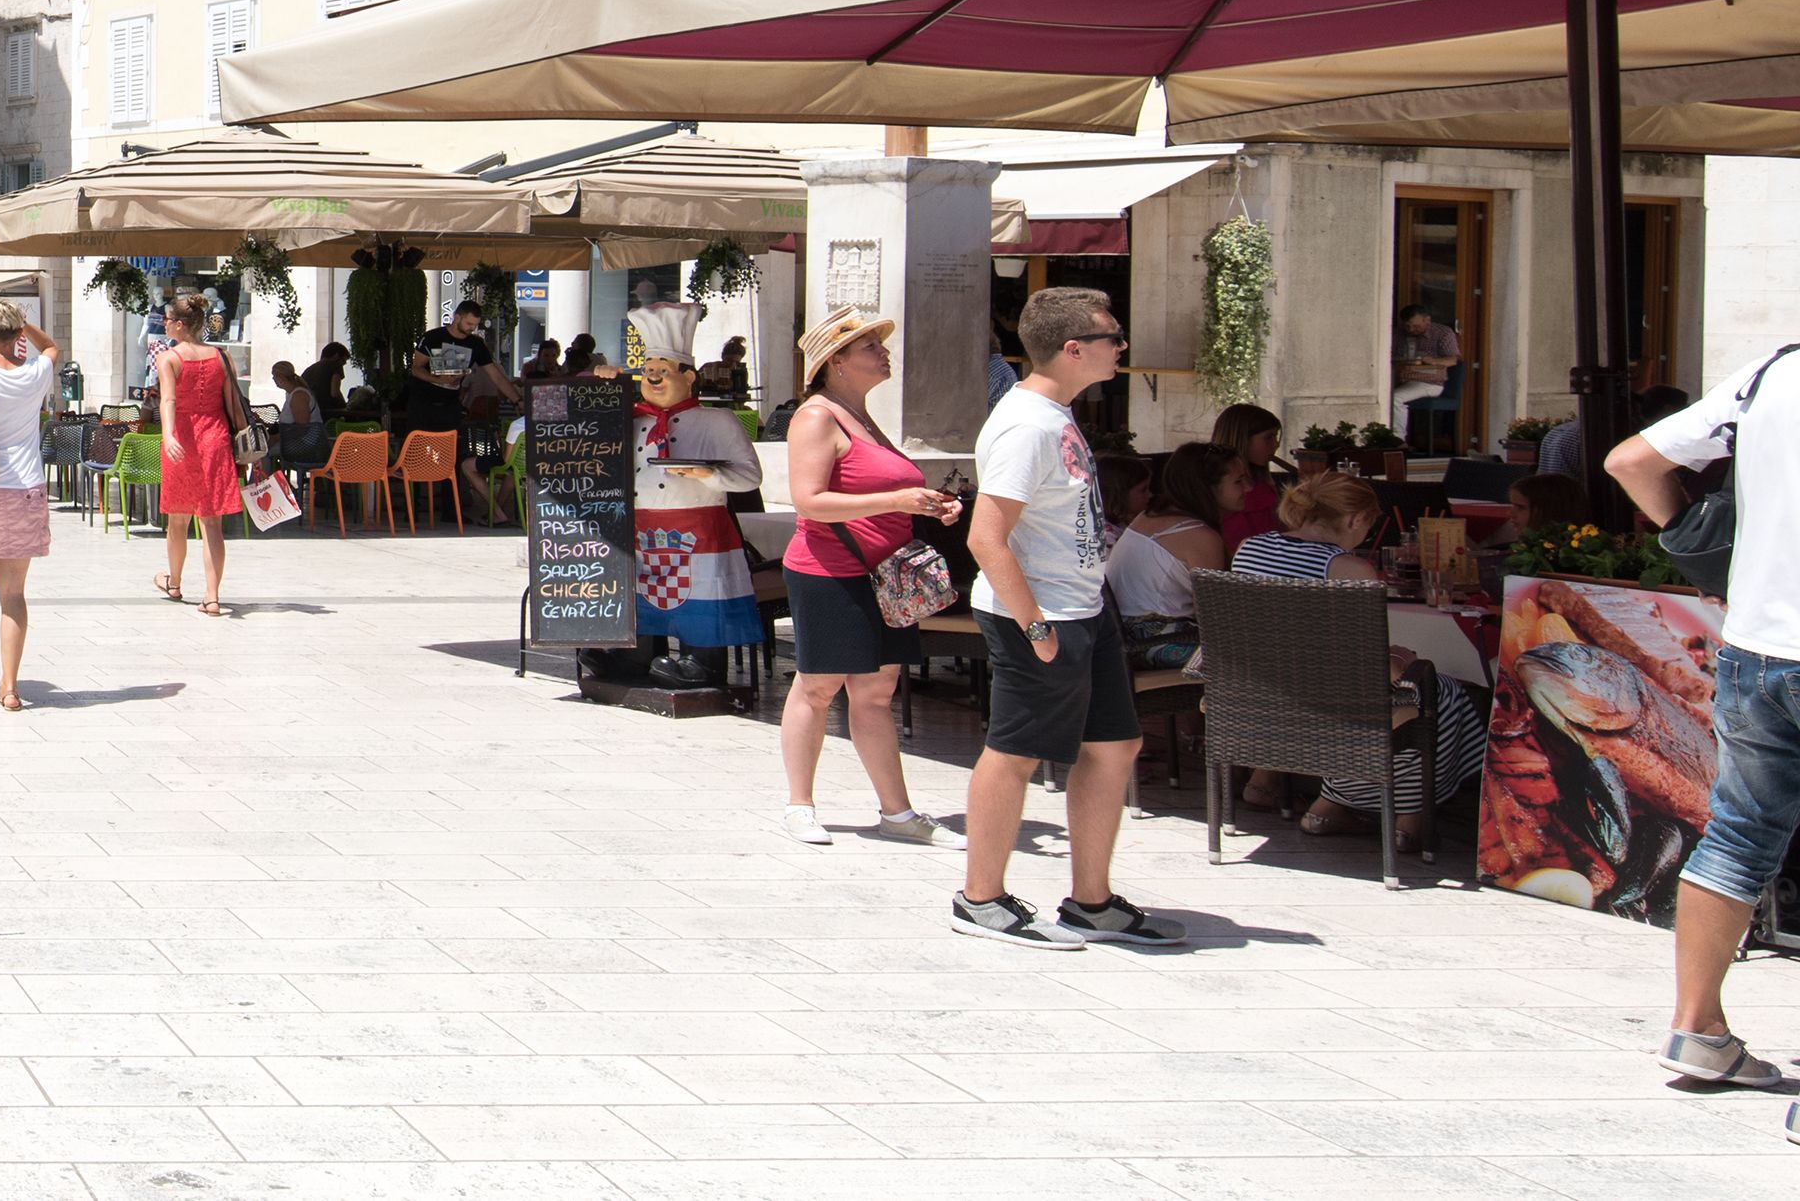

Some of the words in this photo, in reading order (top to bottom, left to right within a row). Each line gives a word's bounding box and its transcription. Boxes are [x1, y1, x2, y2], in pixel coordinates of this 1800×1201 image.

[760, 200, 807, 218] Vivas
[627, 325, 642, 336] SA
[627, 336, 639, 345] UP
[626, 356, 645, 369] OF
[568, 384, 623, 397] KONOBA
[574, 396, 620, 410] PJACA
[535, 420, 600, 437] STEAKS
[536, 438, 623, 457] MEAT/FISH
[536, 458, 612, 477] PLATTER
[538, 477, 595, 495] SQUID
[536, 502, 577, 518] TUNA
[539, 520, 602, 537] PASTA
[1075, 487, 1089, 558] CALIFORNIA
[539, 538, 611, 559] RISOTTO
[539, 561, 605, 582] SALADS
[540, 580, 617, 599] CHICKEN
